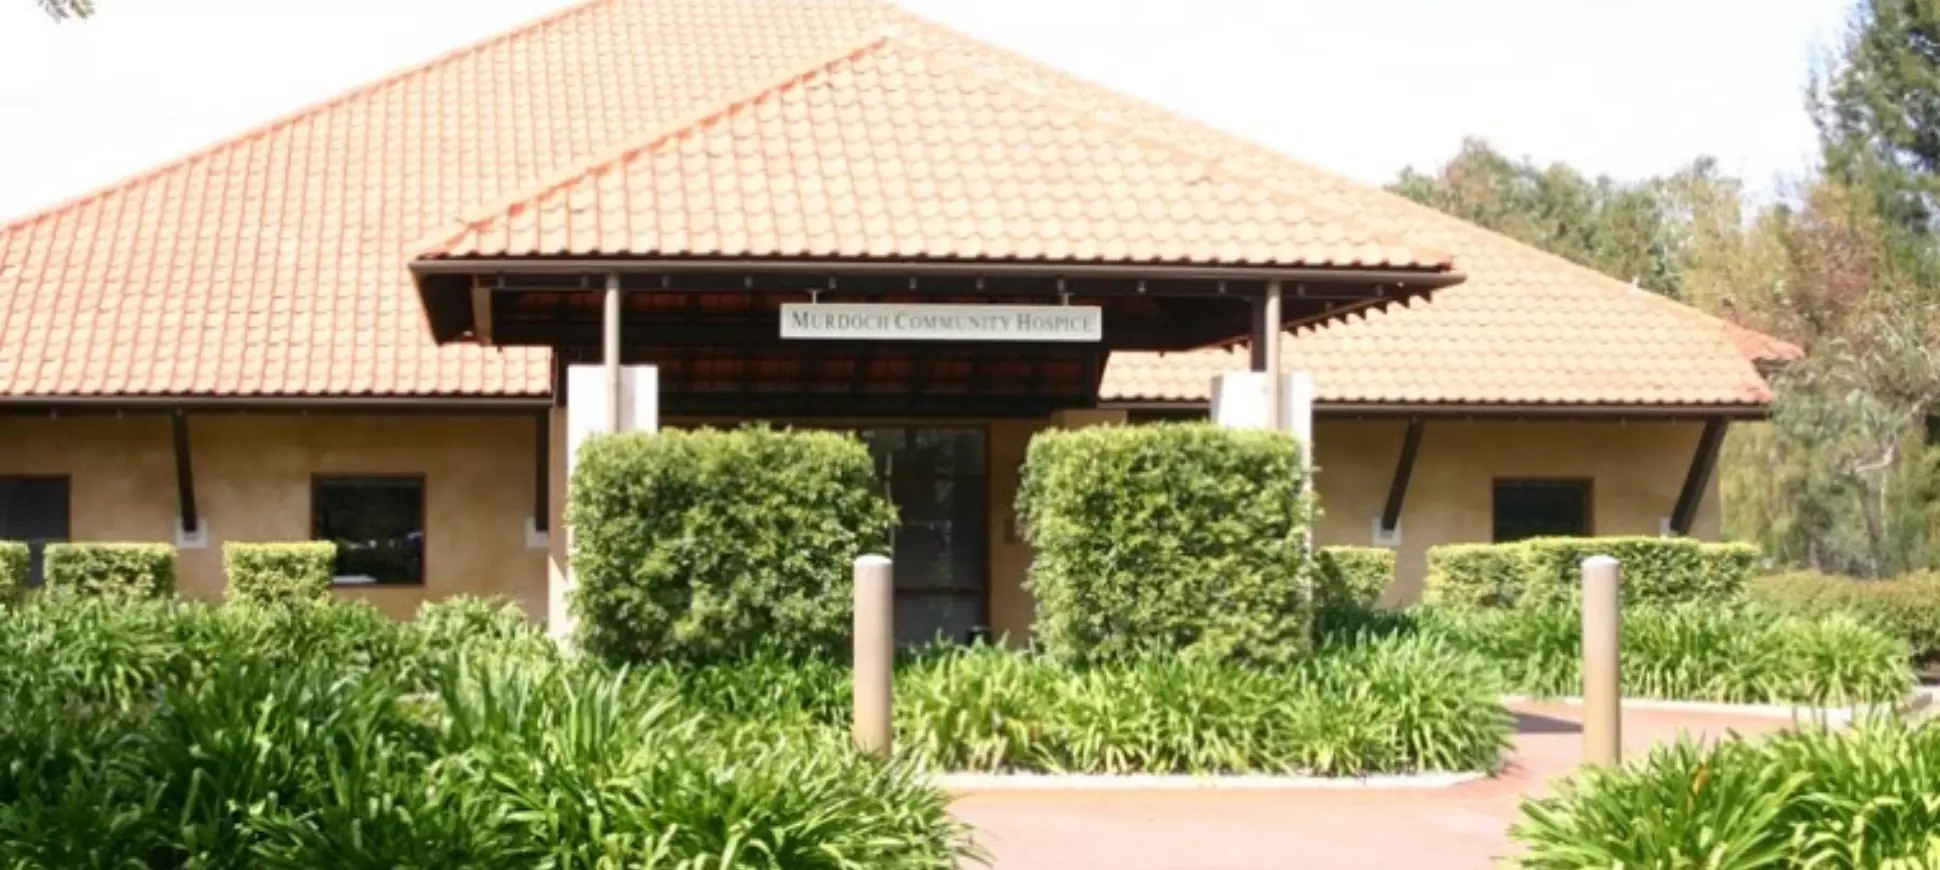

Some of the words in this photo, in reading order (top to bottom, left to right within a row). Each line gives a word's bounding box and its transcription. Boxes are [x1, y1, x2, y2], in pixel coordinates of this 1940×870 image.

[792, 311, 888, 330] MURDOCH
[894, 311, 1011, 331] COMMUNITY
[1016, 314, 1093, 333] HOSPICE
